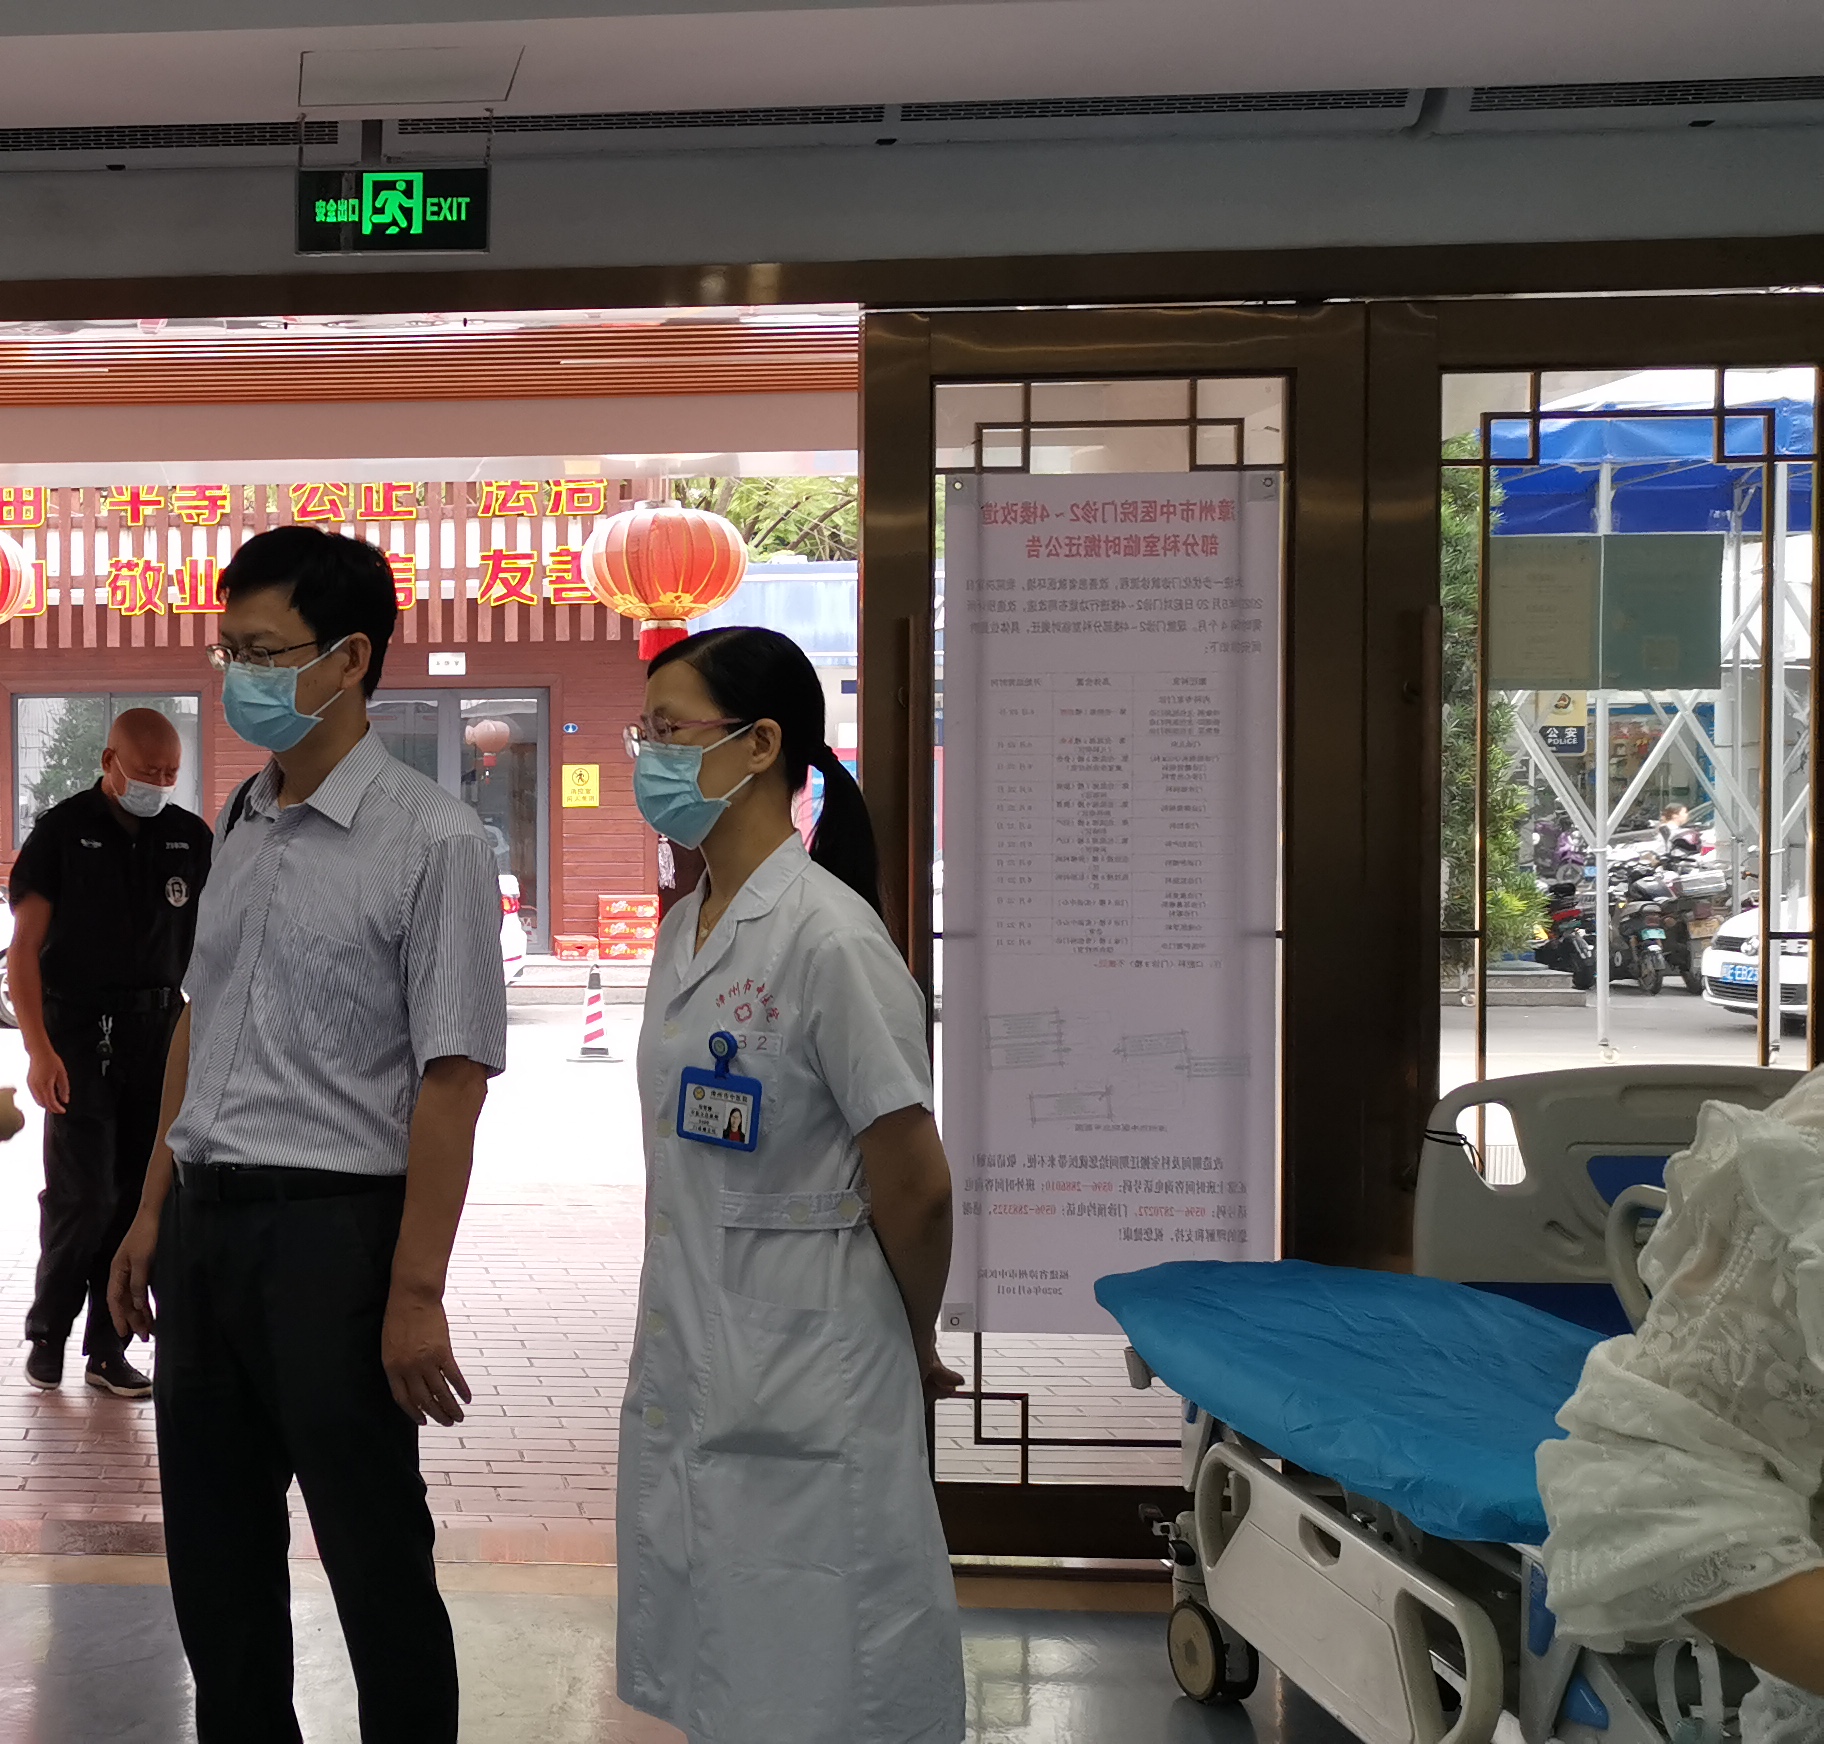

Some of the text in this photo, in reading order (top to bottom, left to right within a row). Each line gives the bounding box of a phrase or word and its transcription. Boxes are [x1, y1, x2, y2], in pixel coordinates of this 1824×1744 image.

[315, 199, 359, 222] 安全出口
[426, 197, 470, 221] EXIT
[1546, 727, 1577, 739] 公安
